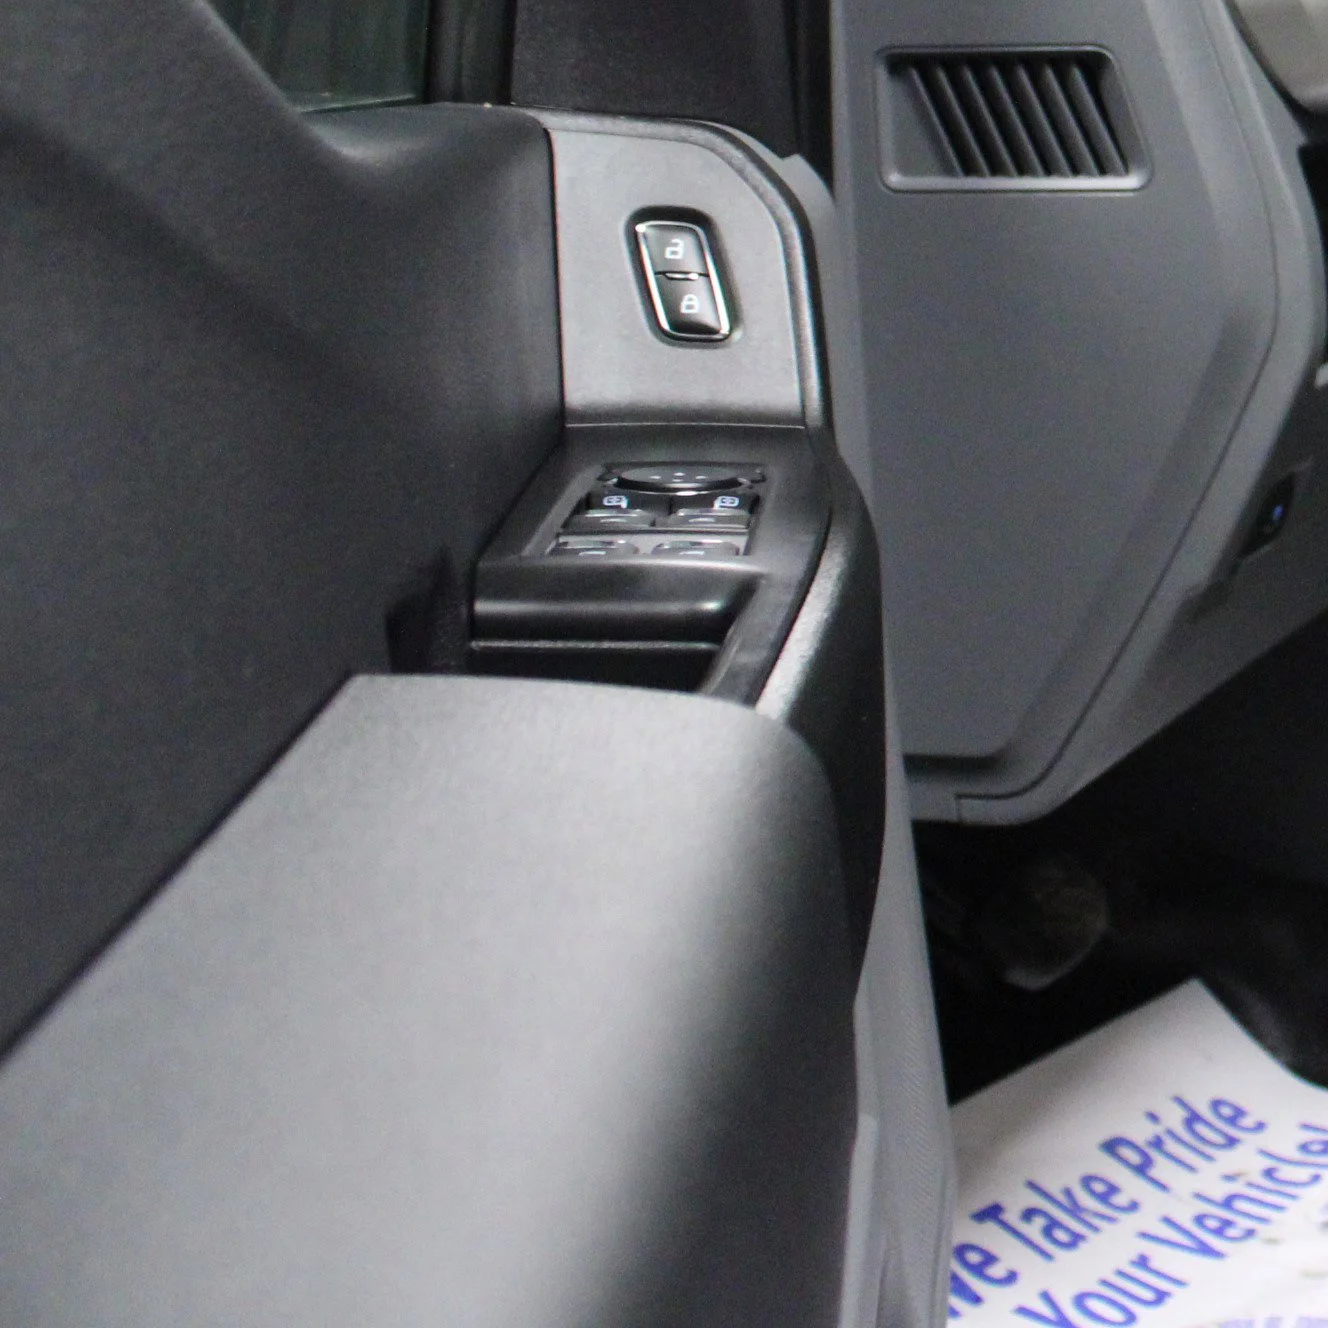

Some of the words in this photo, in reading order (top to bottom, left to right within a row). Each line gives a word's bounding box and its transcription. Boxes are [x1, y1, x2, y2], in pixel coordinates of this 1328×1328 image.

[968, 1174, 1139, 1262] Take
[1098, 1095, 1266, 1193] Pride
[1012, 1254, 1189, 1328] Your
